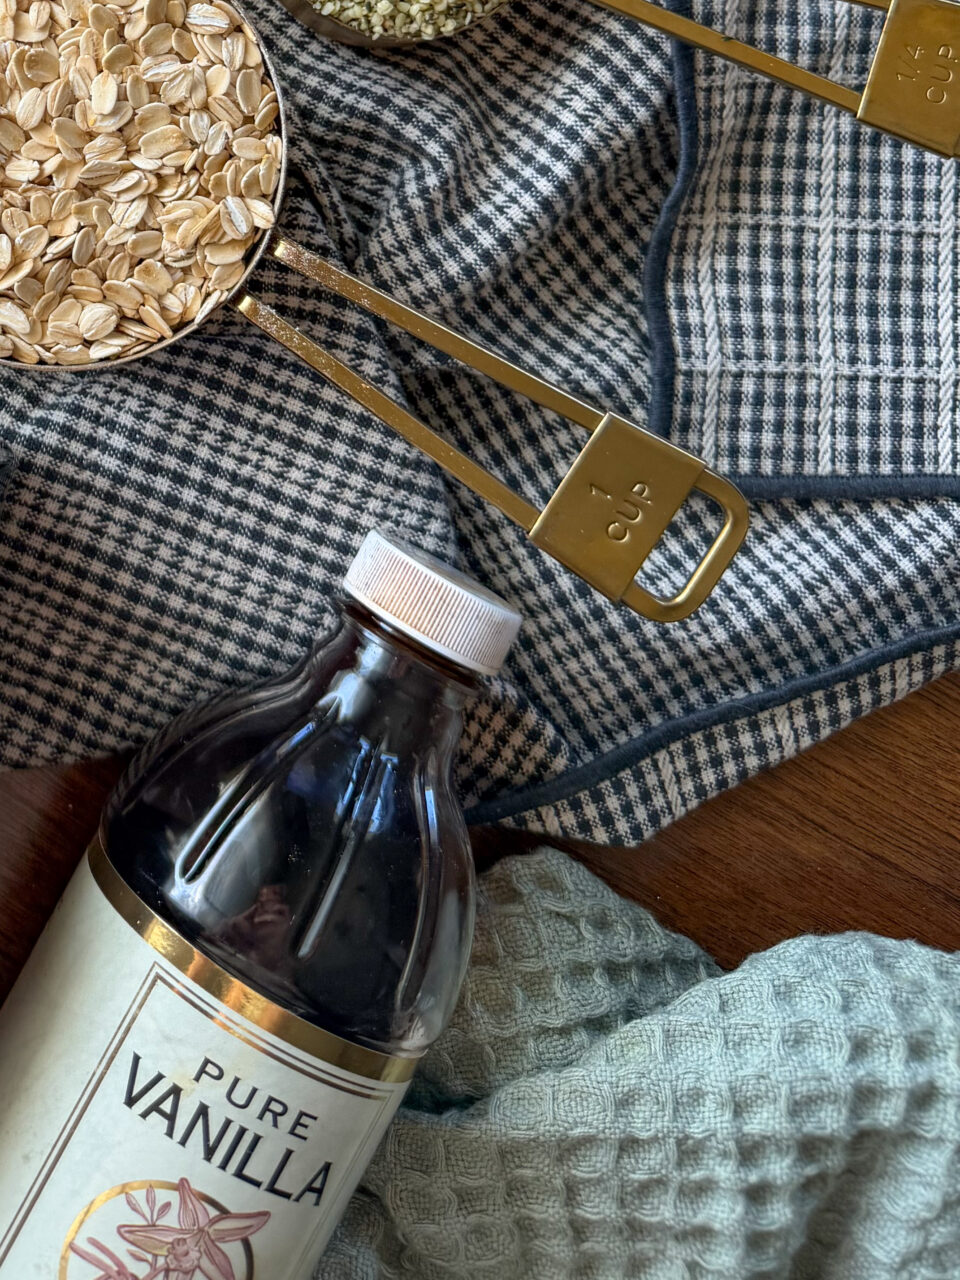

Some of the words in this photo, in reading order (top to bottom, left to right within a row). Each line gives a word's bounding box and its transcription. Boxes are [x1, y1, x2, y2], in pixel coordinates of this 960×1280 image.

[896, 43, 925, 81] 1/4
[926, 44, 959, 104] CUP
[589, 483, 613, 500] 1
[606, 481, 652, 543] CUP
[123, 1051, 333, 1206] VANILLA
[192, 1057, 318, 1141] PURE
